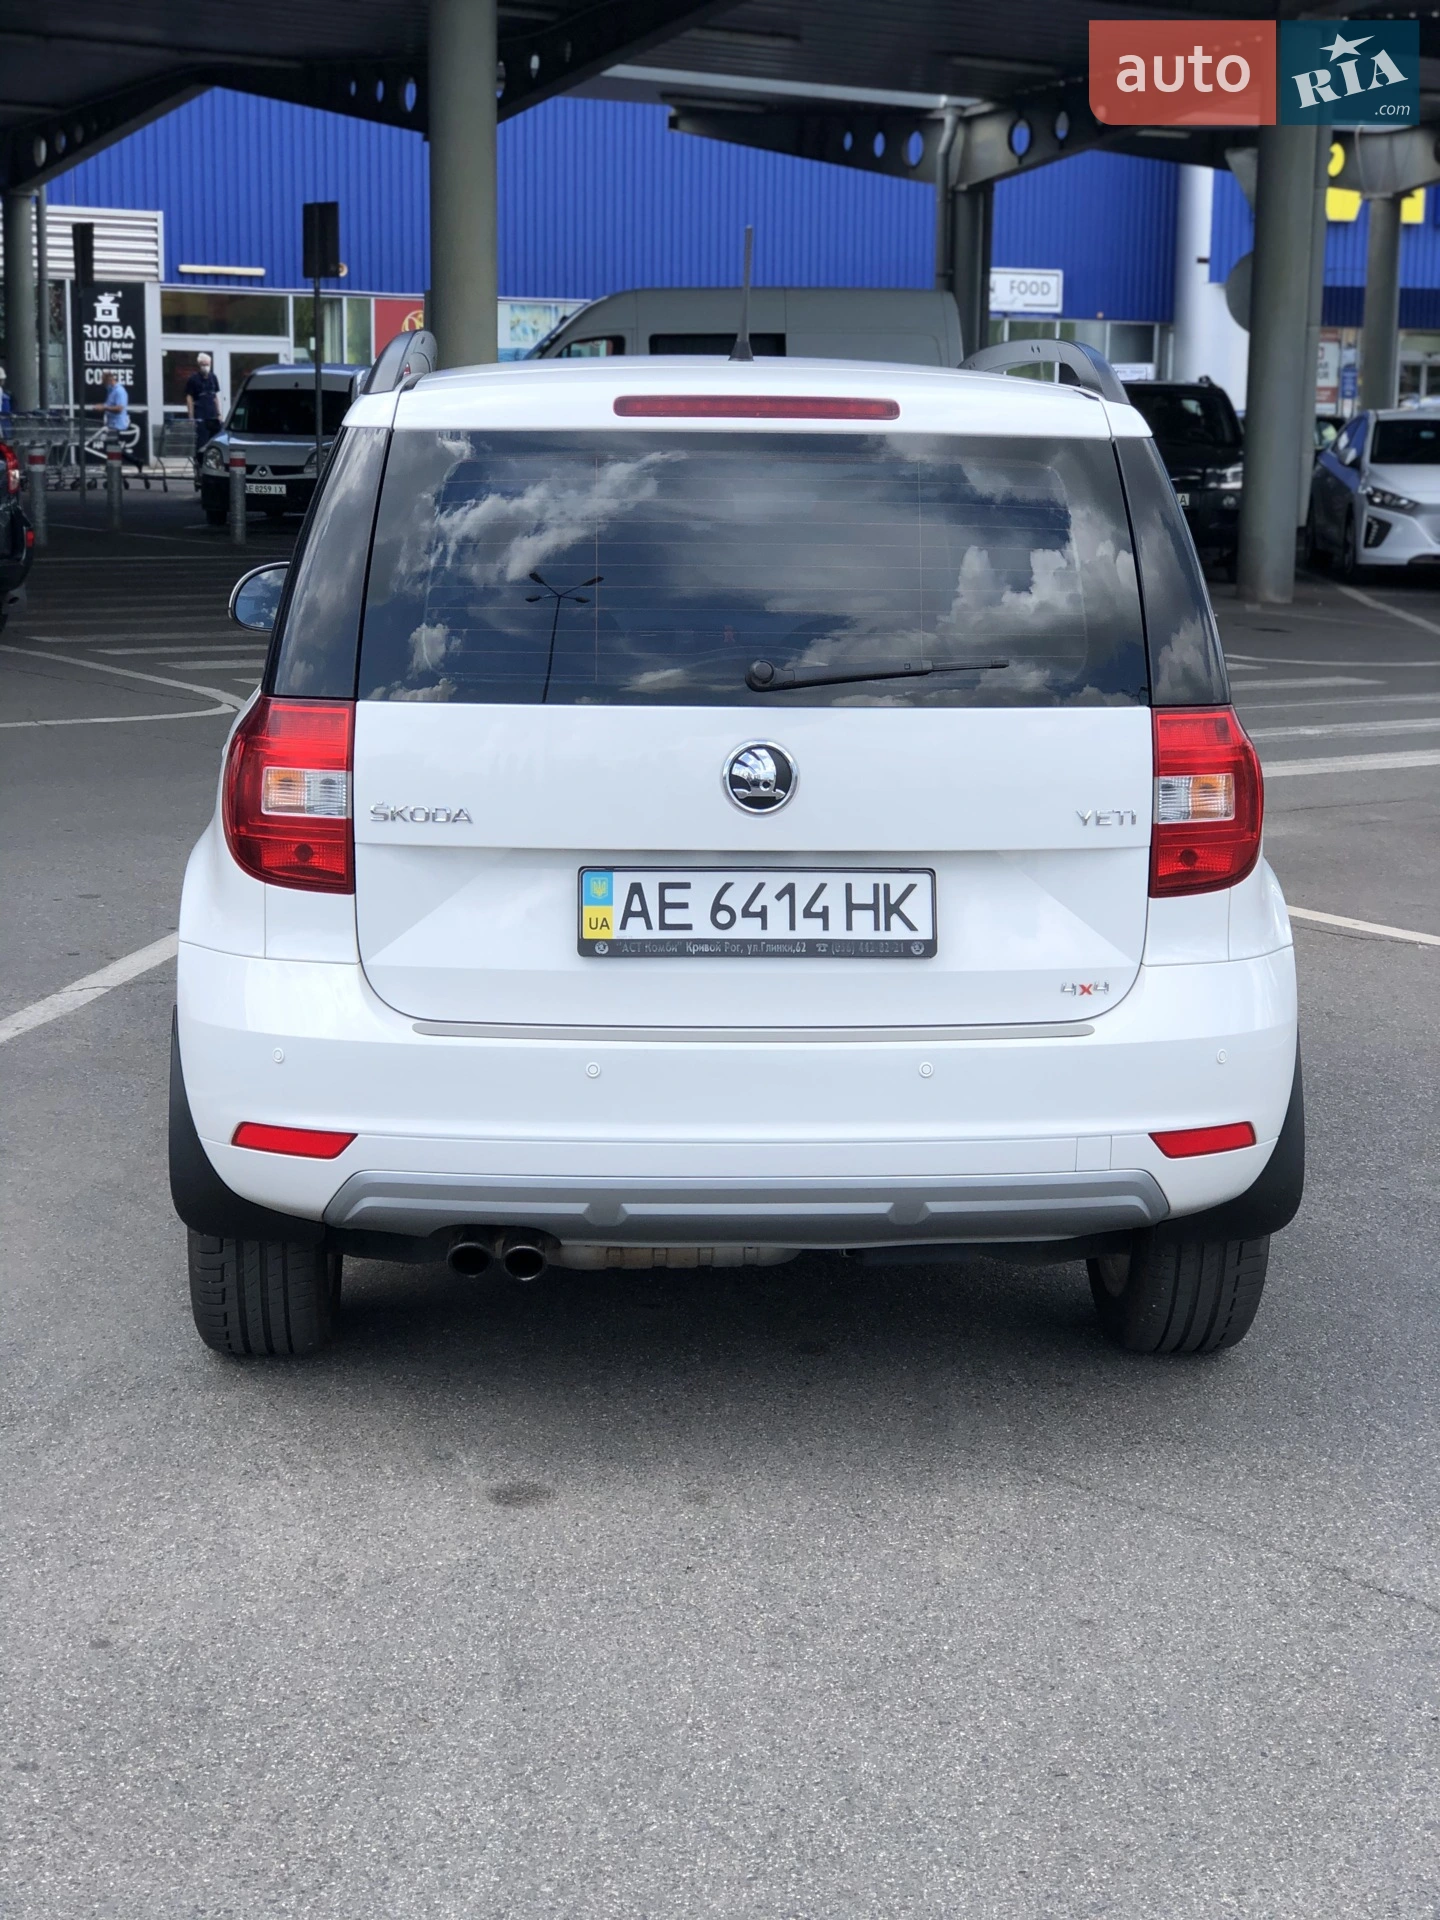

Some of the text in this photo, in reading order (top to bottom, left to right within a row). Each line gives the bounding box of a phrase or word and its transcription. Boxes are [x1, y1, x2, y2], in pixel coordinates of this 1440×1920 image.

[1010, 280, 1051, 296] FOOD
[83, 324, 136, 339] RIOBA
[84, 340, 112, 362] ENJOY
[370, 801, 473, 824] ŠKODA
[1076, 809, 1137, 826] YETI
[619, 881, 918, 932] AE 6414 HK
[588, 917, 610, 931] UA
[685, 940, 722, 955] Кривой
